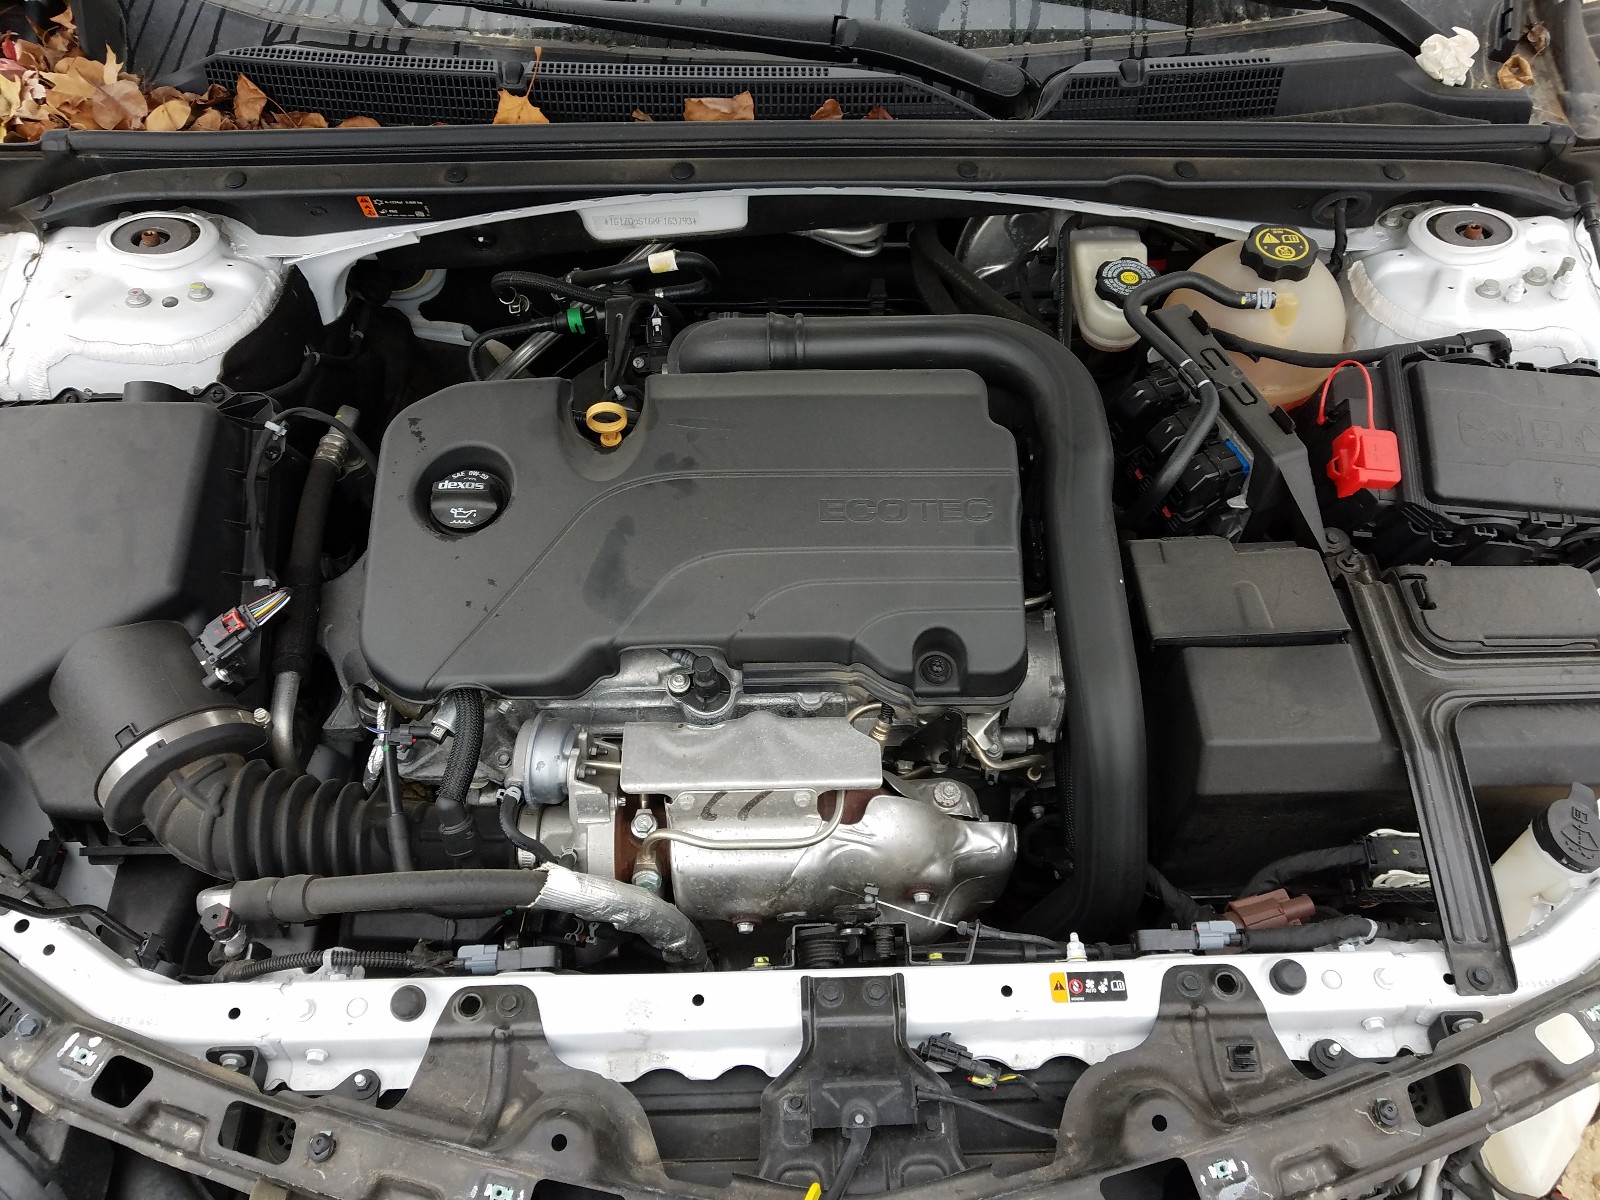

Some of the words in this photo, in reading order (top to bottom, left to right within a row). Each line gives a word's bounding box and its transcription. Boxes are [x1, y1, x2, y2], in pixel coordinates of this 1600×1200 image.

[451, 471, 465, 479] SAE
[468, 470, 489, 480] 0W-20
[438, 480, 484, 490] dexos
[819, 498, 993, 523] ECOTEC
